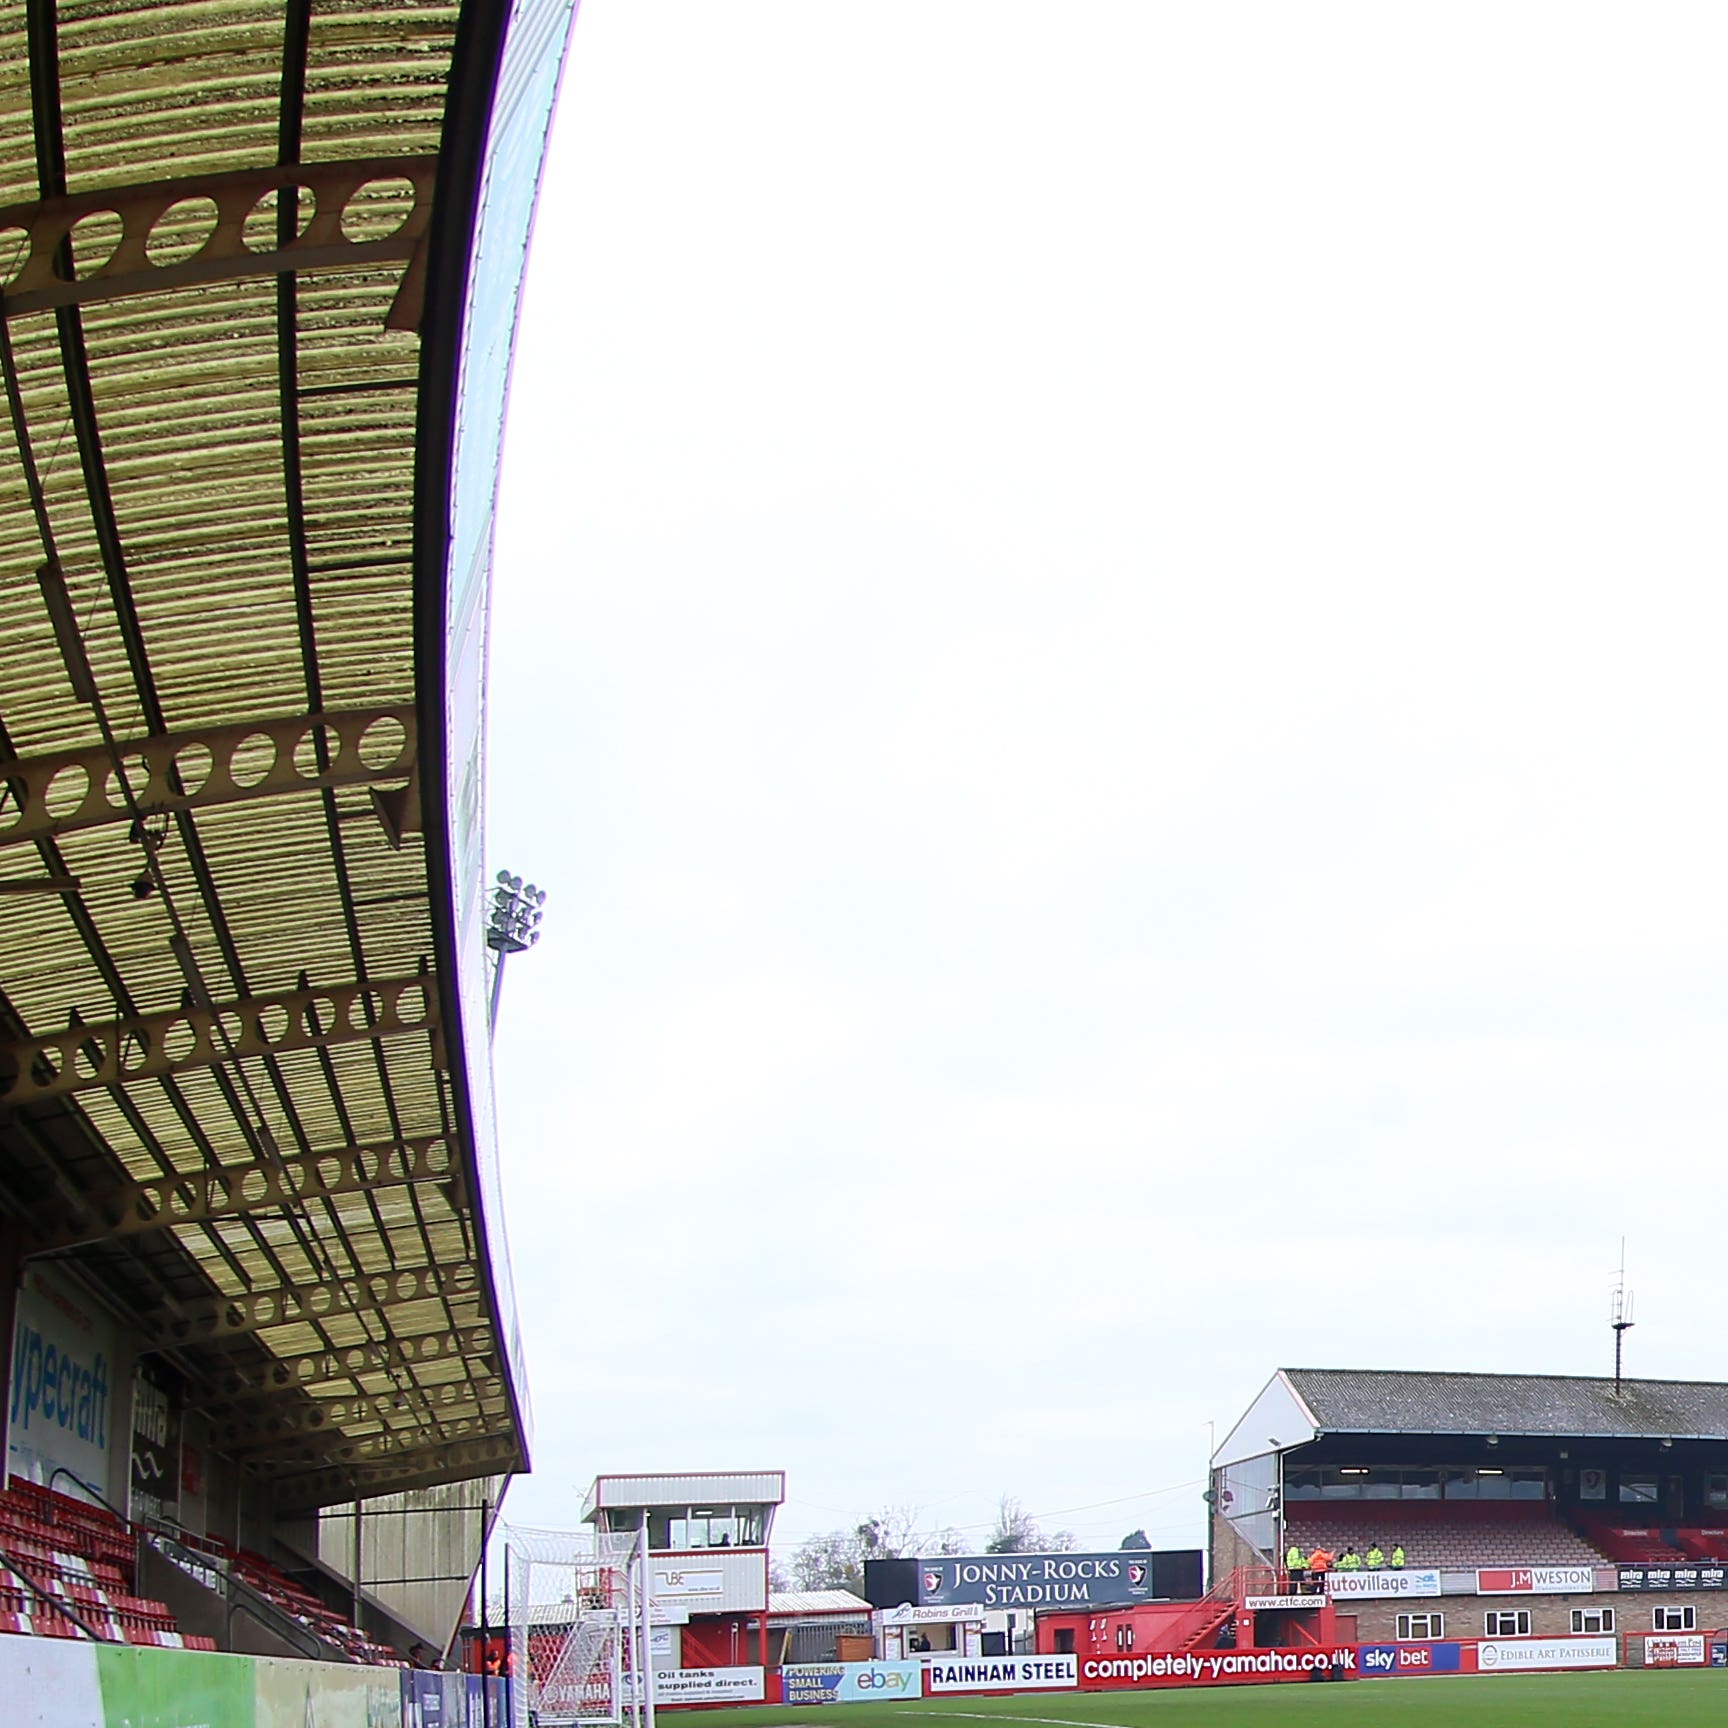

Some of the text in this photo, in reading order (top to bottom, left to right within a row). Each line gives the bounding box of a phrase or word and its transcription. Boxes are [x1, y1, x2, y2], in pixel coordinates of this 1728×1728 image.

[10, 1322, 107, 1450] ypecraft
[953, 1559, 1120, 1590] JONNY-ROCKS
[1534, 1569, 1592, 1585] WESTON
[1324, 1574, 1408, 1594] autovillage
[985, 1583, 1089, 1605] STADIUM
[1249, 1597, 1323, 1608] www.ctfc.com
[912, 1607, 948, 1619] Robins
[1364, 1648, 1428, 1670] sky bet
[1501, 1646, 1612, 1660] EDIBLE ART PATISSERIE
[788, 1665, 845, 1677] POWERING
[932, 1661, 1076, 1684] RAINHAM STEEL
[658, 1679, 757, 1690] supplied direct.
[788, 1677, 823, 1689] SMALL
[857, 1667, 911, 1692] ebay
[789, 1689, 839, 1701] BUSINESS
